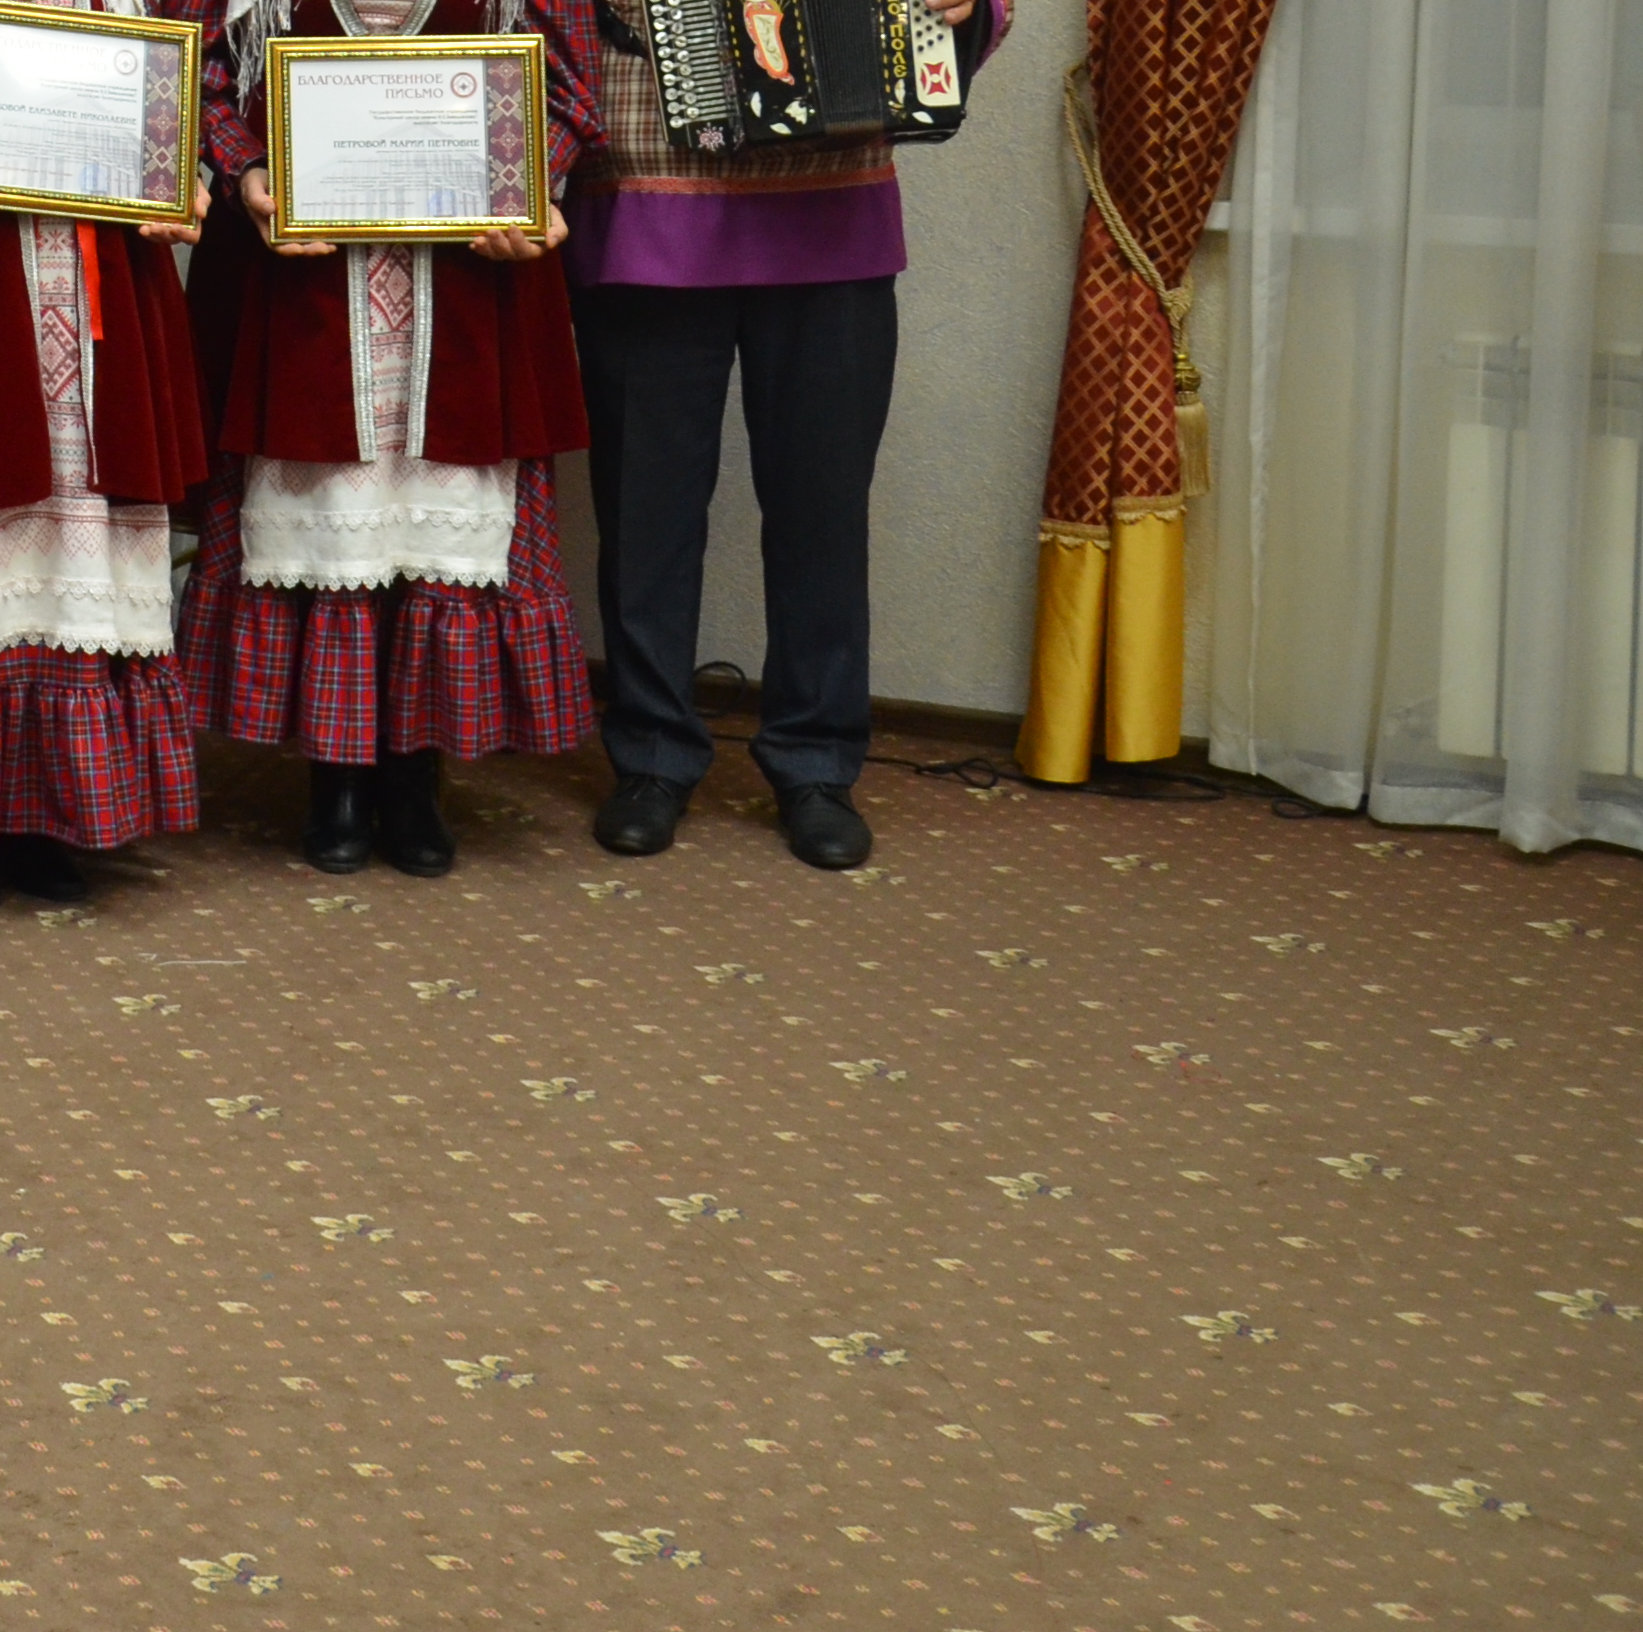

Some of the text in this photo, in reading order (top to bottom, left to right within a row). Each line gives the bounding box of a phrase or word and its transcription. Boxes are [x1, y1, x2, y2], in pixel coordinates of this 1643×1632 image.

[889, 24, 908, 78] ПОЛЕ
[297, 73, 443, 86] БЛАГОДАРСТВЕННОЕ
[385, 88, 444, 99] ПИСЬМО
[333, 139, 480, 148] ПЕТРОВОЙ МАРИИ ПЕТРОВНЕ
